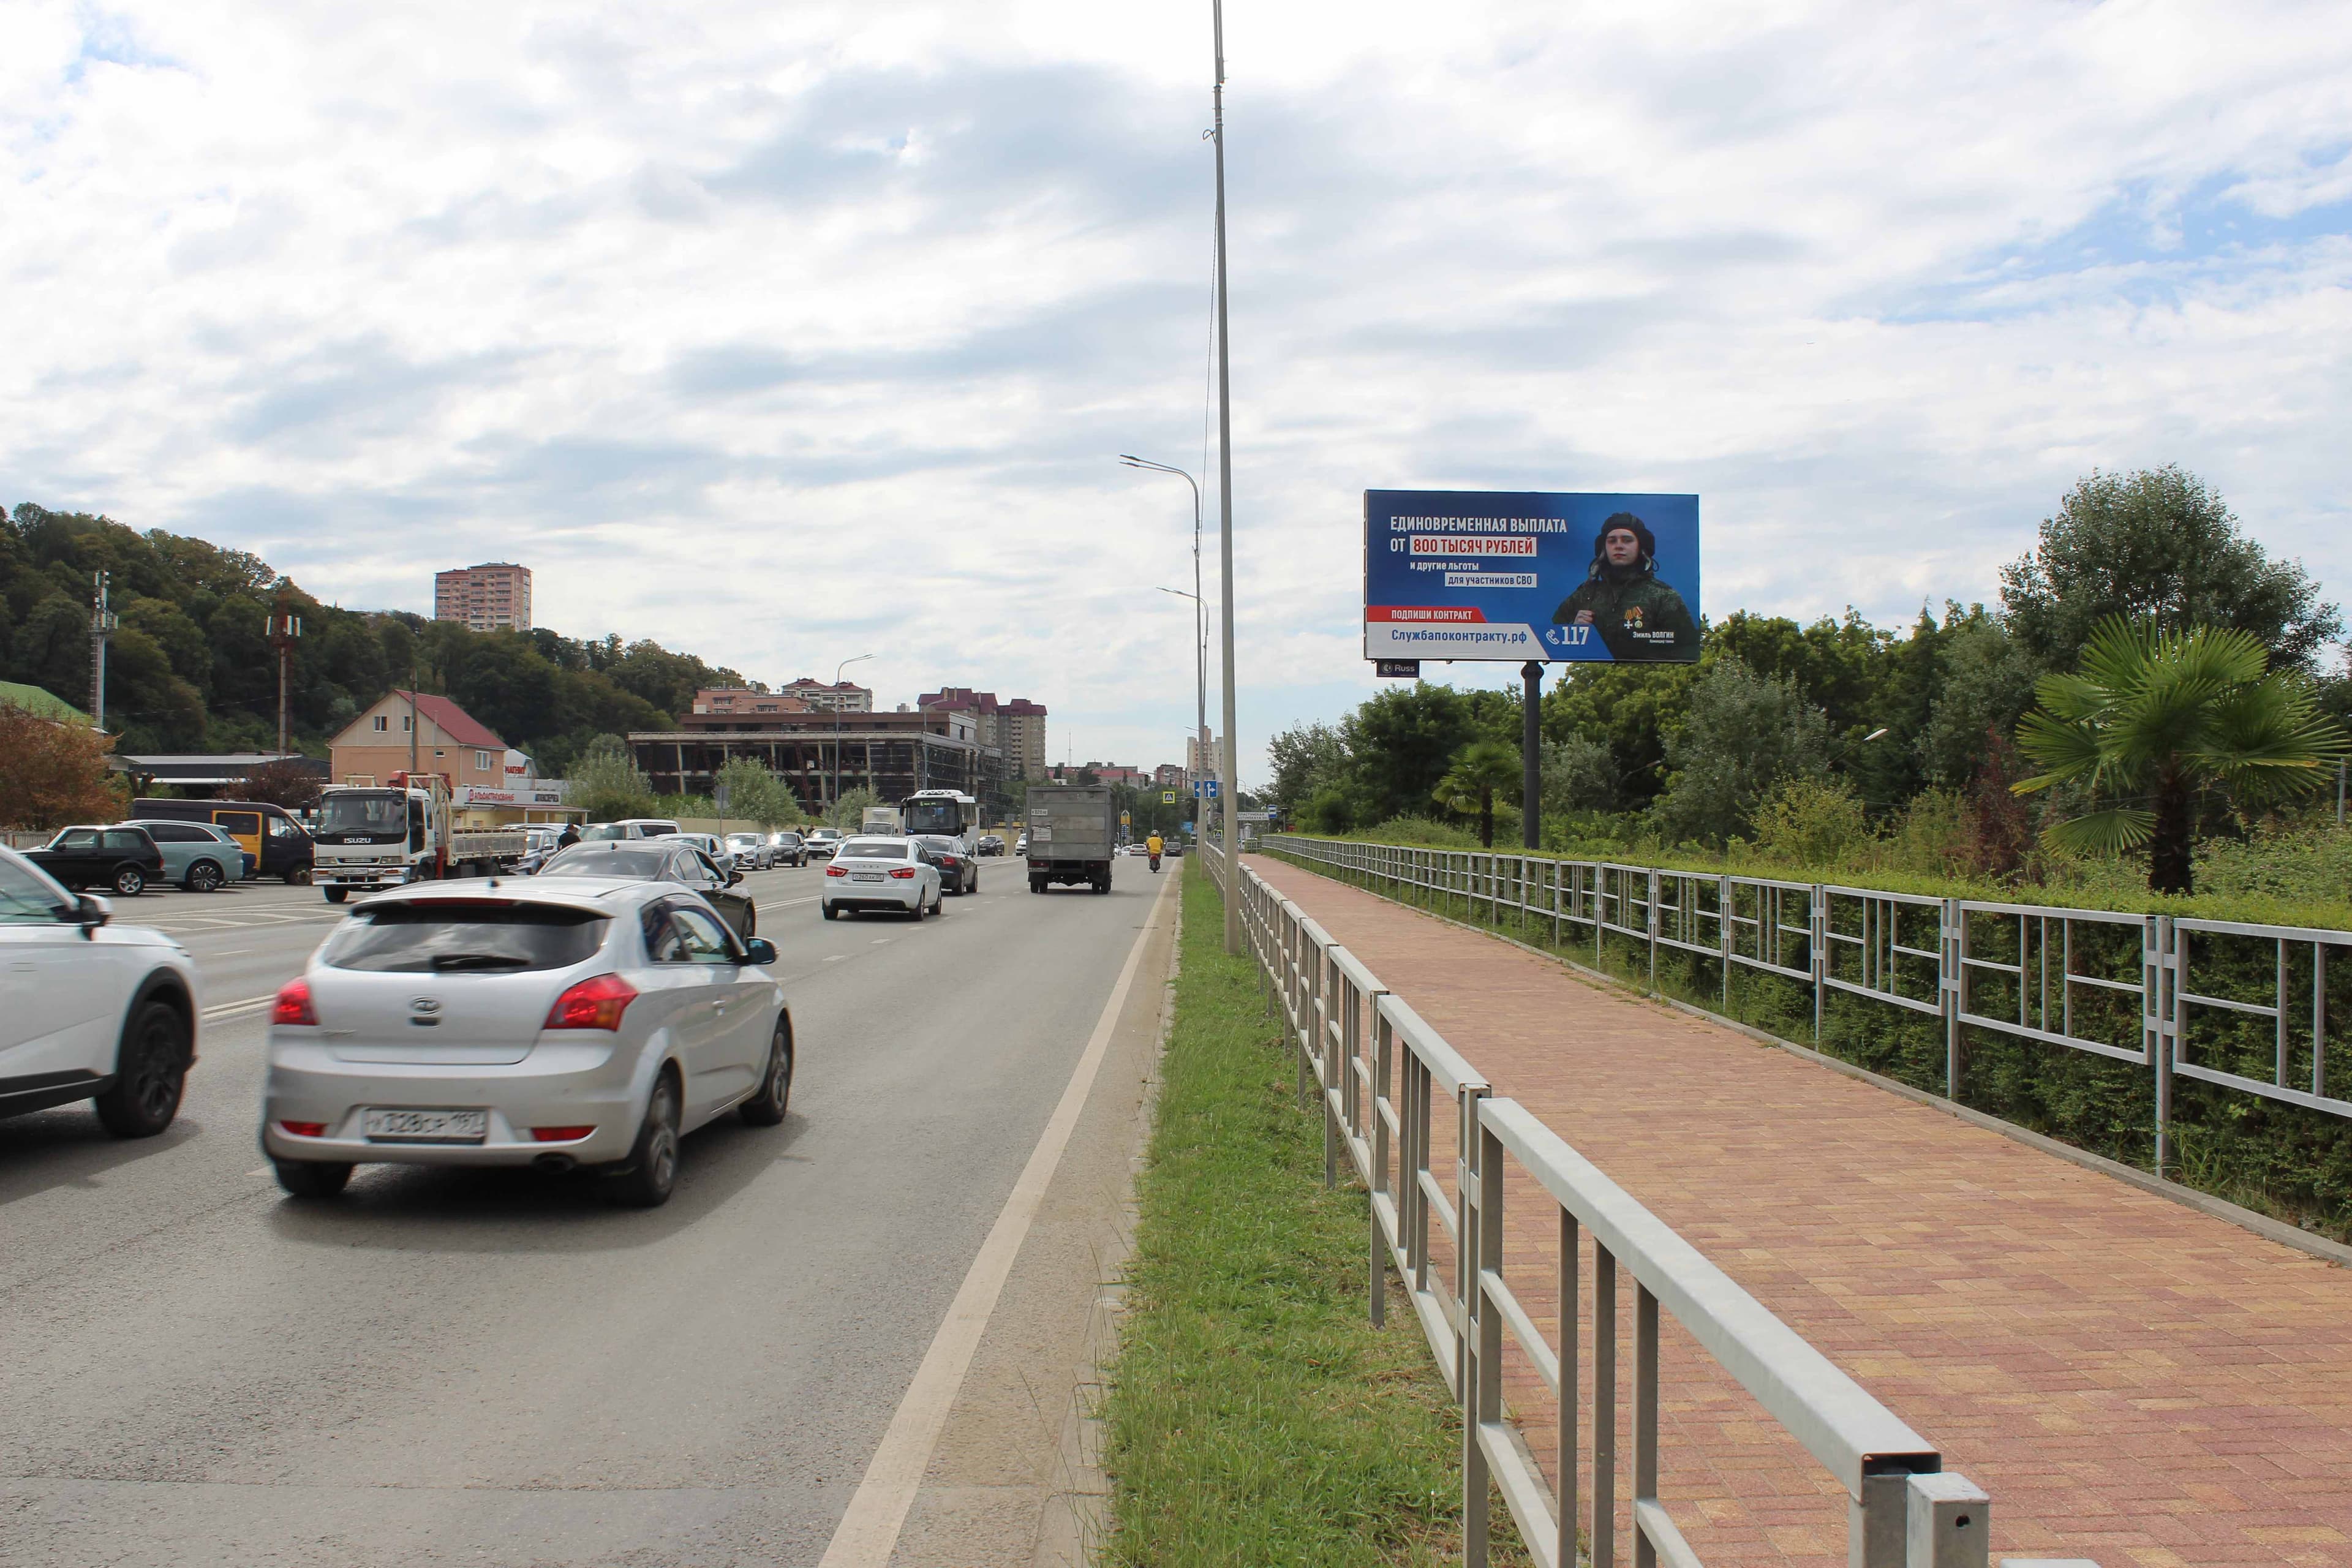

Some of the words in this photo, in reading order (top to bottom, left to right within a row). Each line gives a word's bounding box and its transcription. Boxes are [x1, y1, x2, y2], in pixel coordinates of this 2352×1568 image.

[1390, 516, 1507, 532] ЕДИНОВРЕМЕННАЯ
[1510, 518, 1567, 532] ВЫПЛАТА
[1390, 538, 1406, 552] ОТ
[1414, 539, 1438, 552] 800
[1441, 539, 1482, 553] ТЫСЯЧ
[1486, 537, 1532, 554] РУБЛЕЙ
[1417, 562, 1447, 571] другие
[1448, 562, 1479, 571] льготы
[1448, 576, 1464, 585] для
[1466, 576, 1514, 586] участников
[1516, 576, 1532, 585] СВО
[1391, 610, 1431, 620] ПОДПИШИ
[1433, 611, 1472, 620] КОНТРАКТ
[1392, 629, 1528, 644] Службапоконтракту.рф
[1562, 626, 1589, 645] 117
